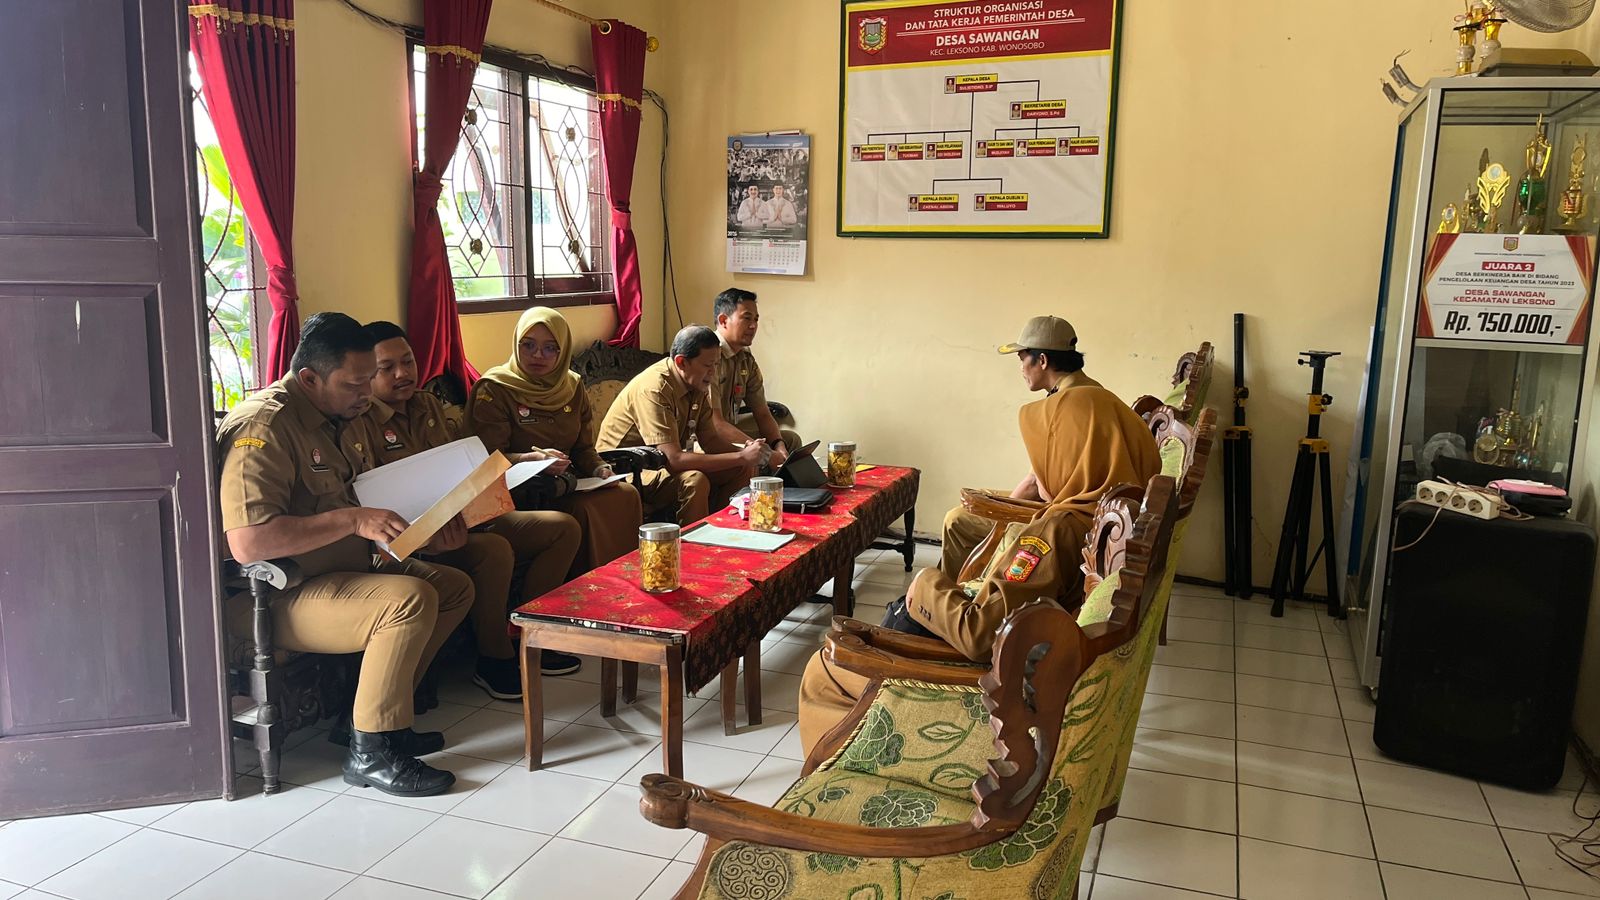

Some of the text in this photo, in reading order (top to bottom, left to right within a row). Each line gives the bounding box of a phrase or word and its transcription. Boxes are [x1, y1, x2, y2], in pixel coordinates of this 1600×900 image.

[934, 1, 1043, 18] STRUKTUR ORGANISASI
[905, 9, 1075, 31] DAN TATA KERJA PEMERINTAH DESA
[936, 29, 1040, 46] DESA SAWANGAN
[946, 47, 980, 55] LEKSONO
[981, 45, 997, 53] KAB.
[999, 41, 1045, 51] WONOSOBO
[1484, 262, 1533, 271] JUARA 2
[1453, 296, 1556, 306] KECAMATAN LEKSONO
[1492, 290, 1546, 298] SAWANGAN
[1443, 310, 1562, 337] Rp. 750.000,-
